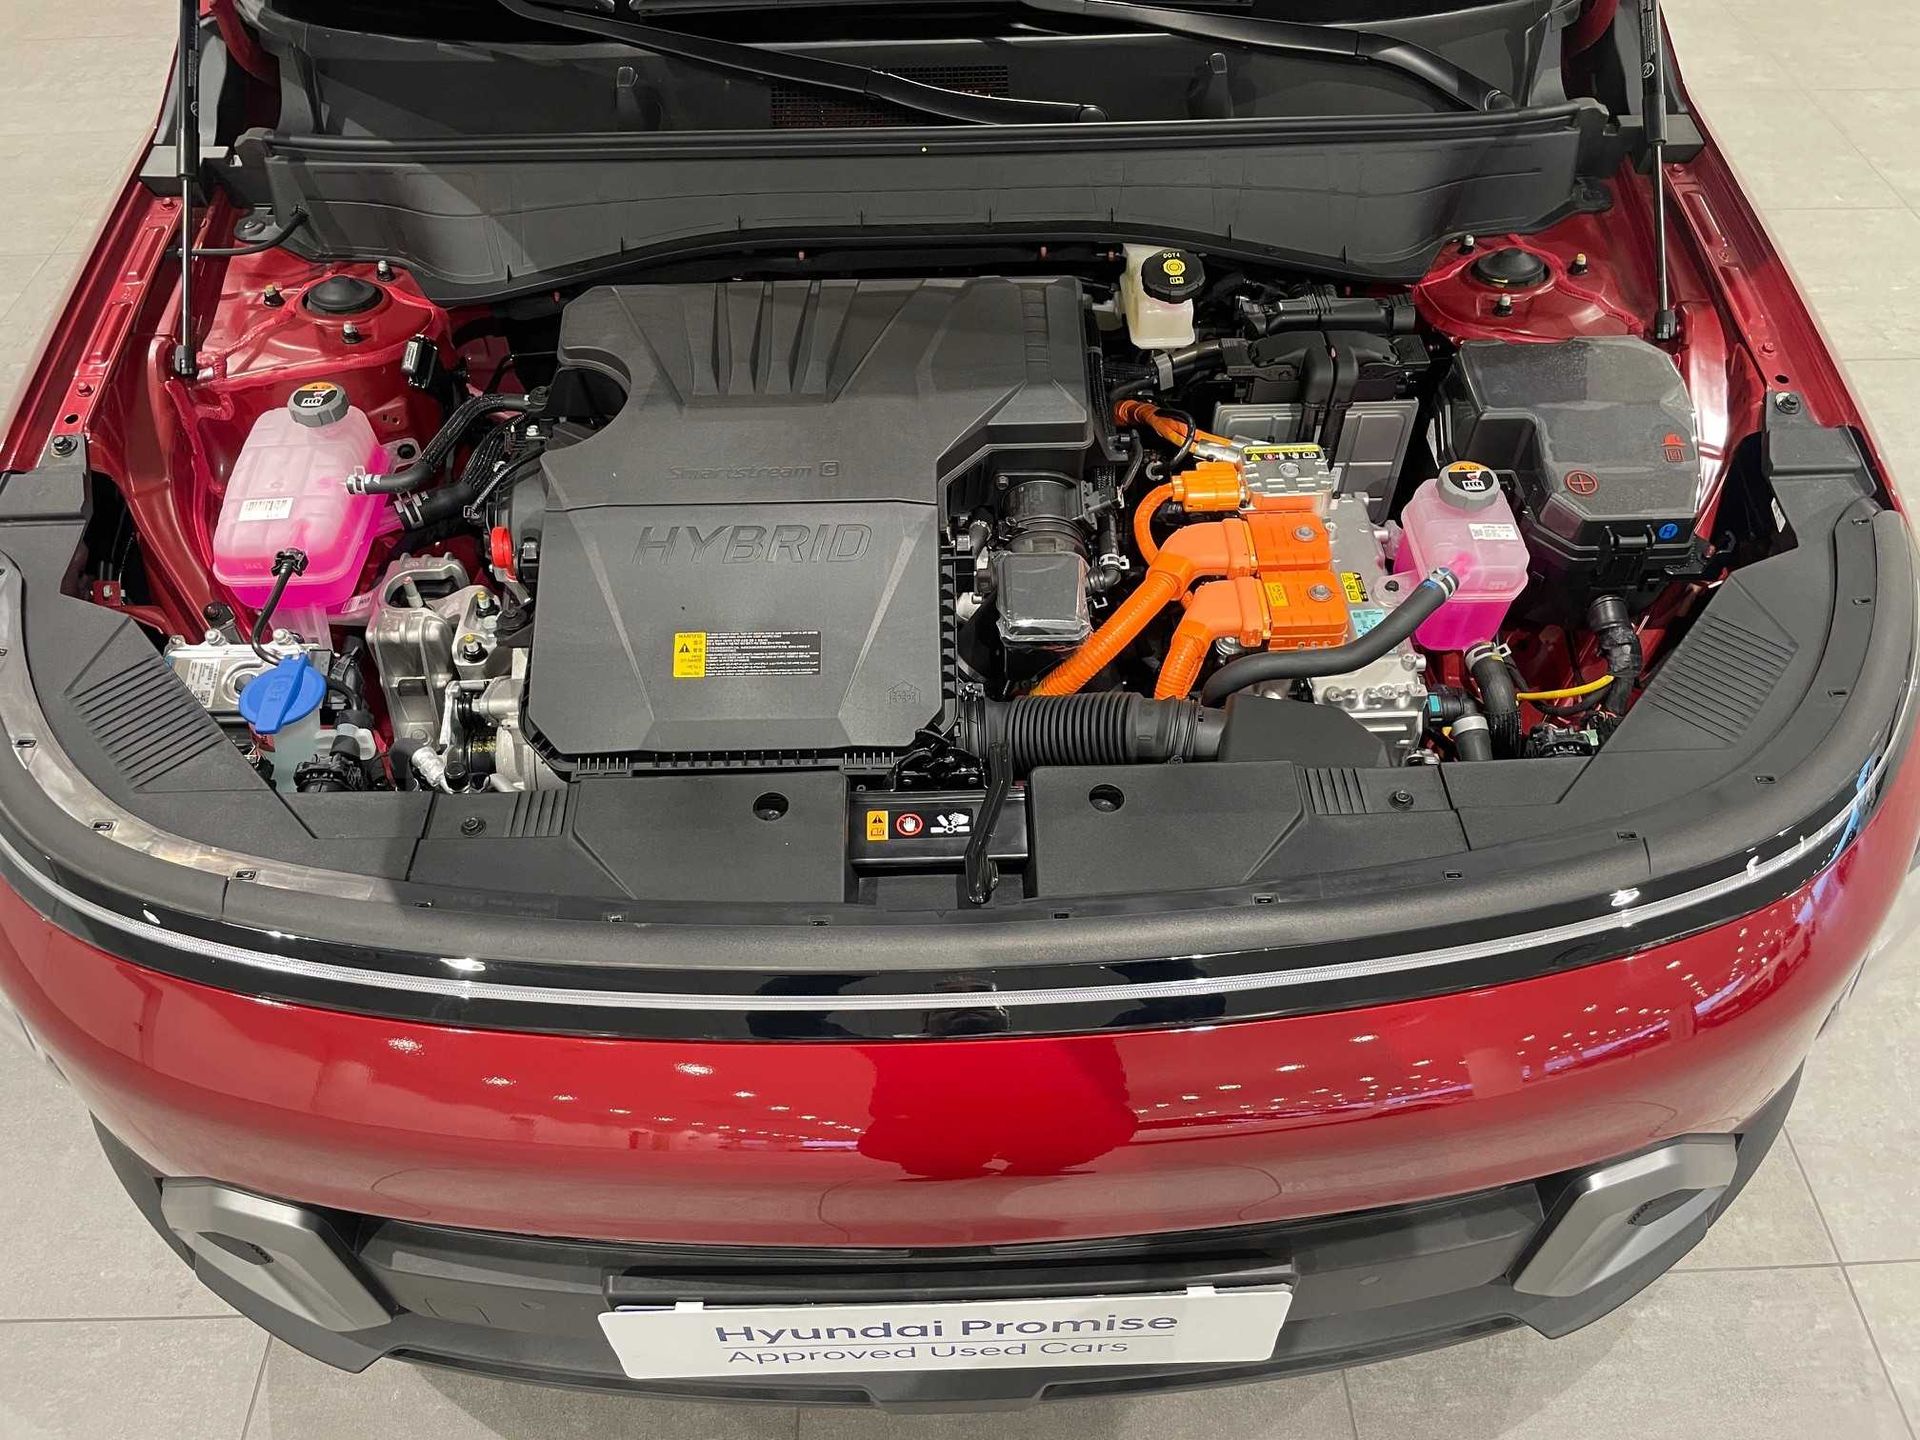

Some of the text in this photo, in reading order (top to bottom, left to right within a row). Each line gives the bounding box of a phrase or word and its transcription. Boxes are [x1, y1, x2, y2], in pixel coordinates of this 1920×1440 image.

[667, 465, 812, 480] Smartstream
[632, 524, 873, 564] HYBRID
[716, 1314, 1178, 1344] Hyundai Promise
[729, 1342, 1128, 1364] Approved Used Cars
